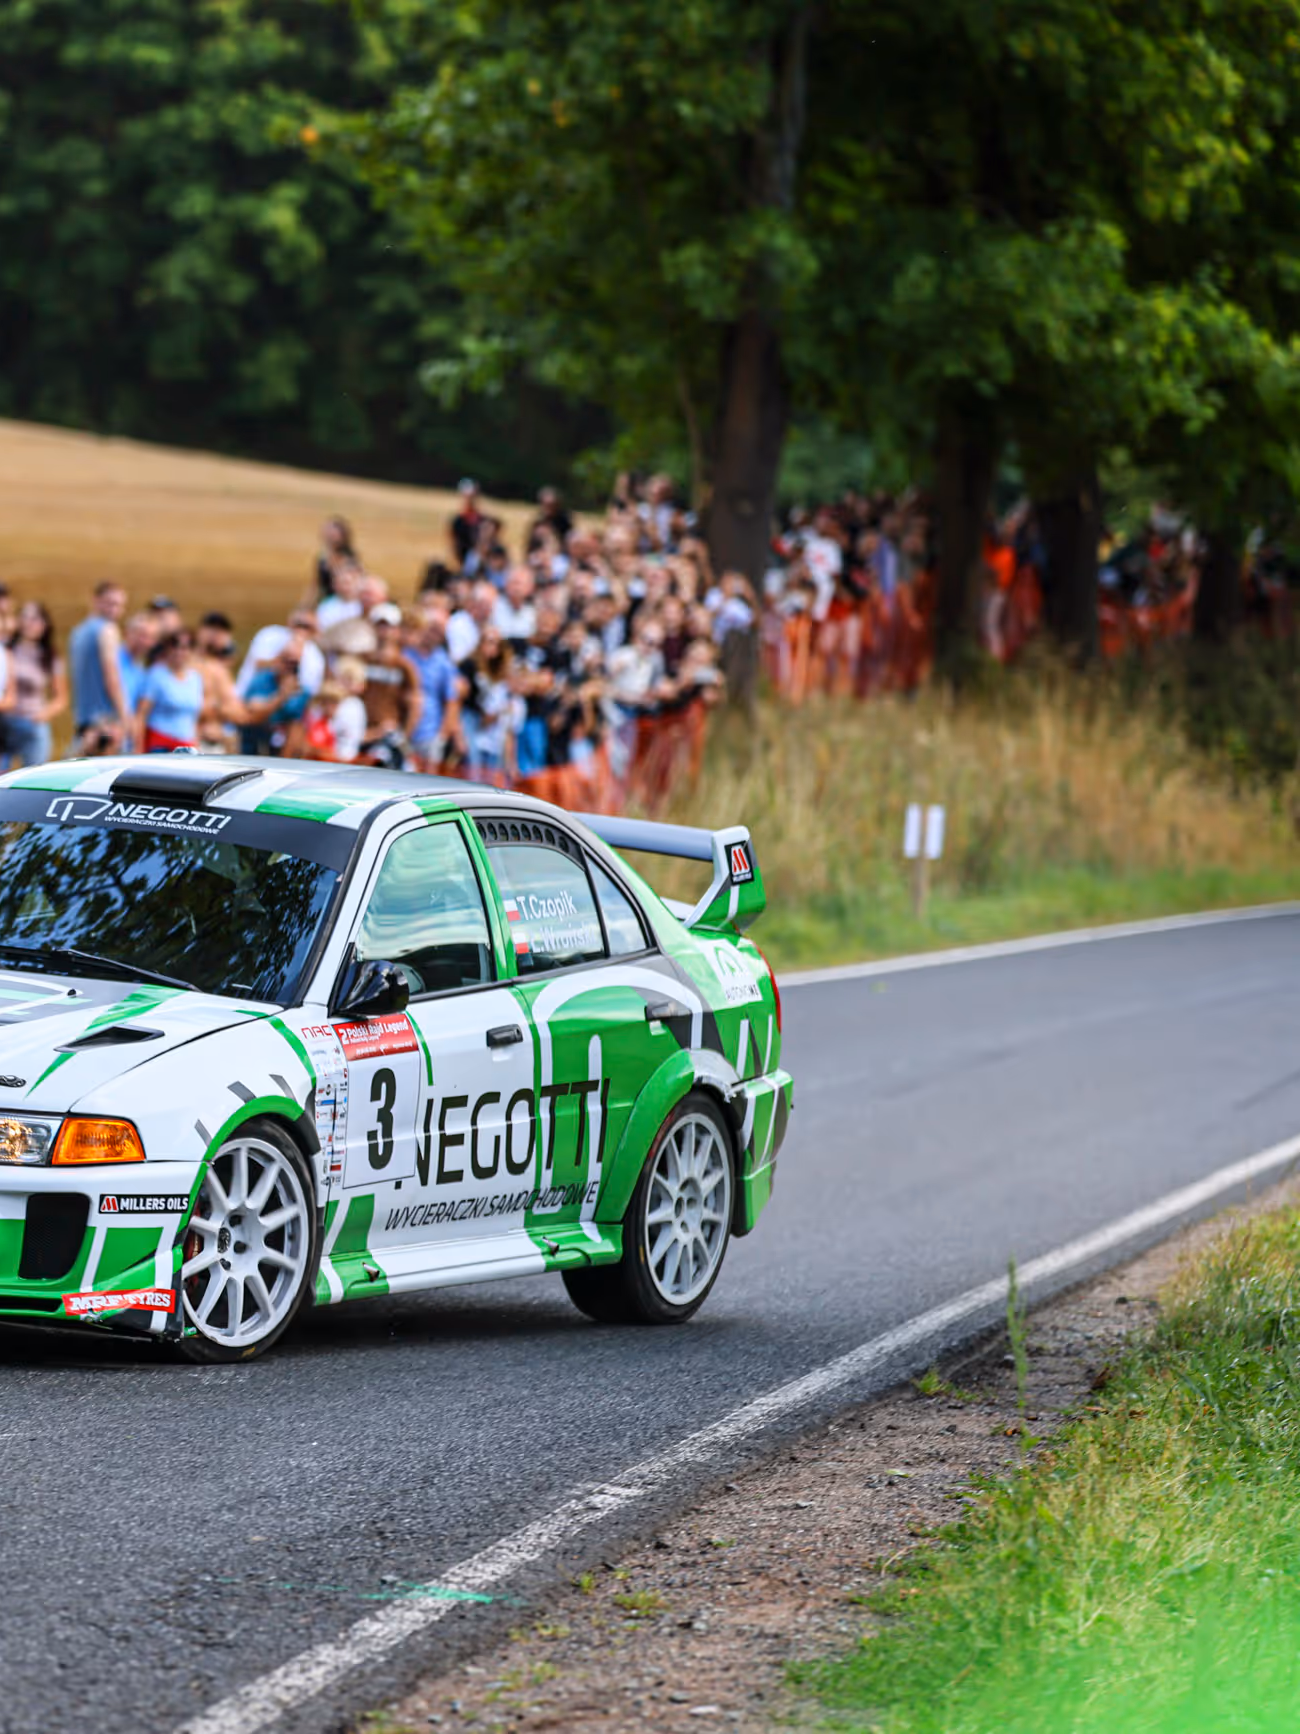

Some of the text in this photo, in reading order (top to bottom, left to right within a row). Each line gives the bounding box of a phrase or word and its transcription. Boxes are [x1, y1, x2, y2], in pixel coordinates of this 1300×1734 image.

[108, 802, 232, 829] NEGOTTI
[516, 890, 577, 921] T.Czopik
[347, 1025, 368, 1039] Polski
[367, 1067, 396, 1170] 3
[395, 1077, 610, 1189] NEGOTTI
[120, 1197, 165, 1211] MILLERS
[167, 1197, 189, 1211] OILS
[385, 1181, 600, 1231] WYCIERACZKI SAMOCHODOWE
[126, 1292, 171, 1307] TYRES
